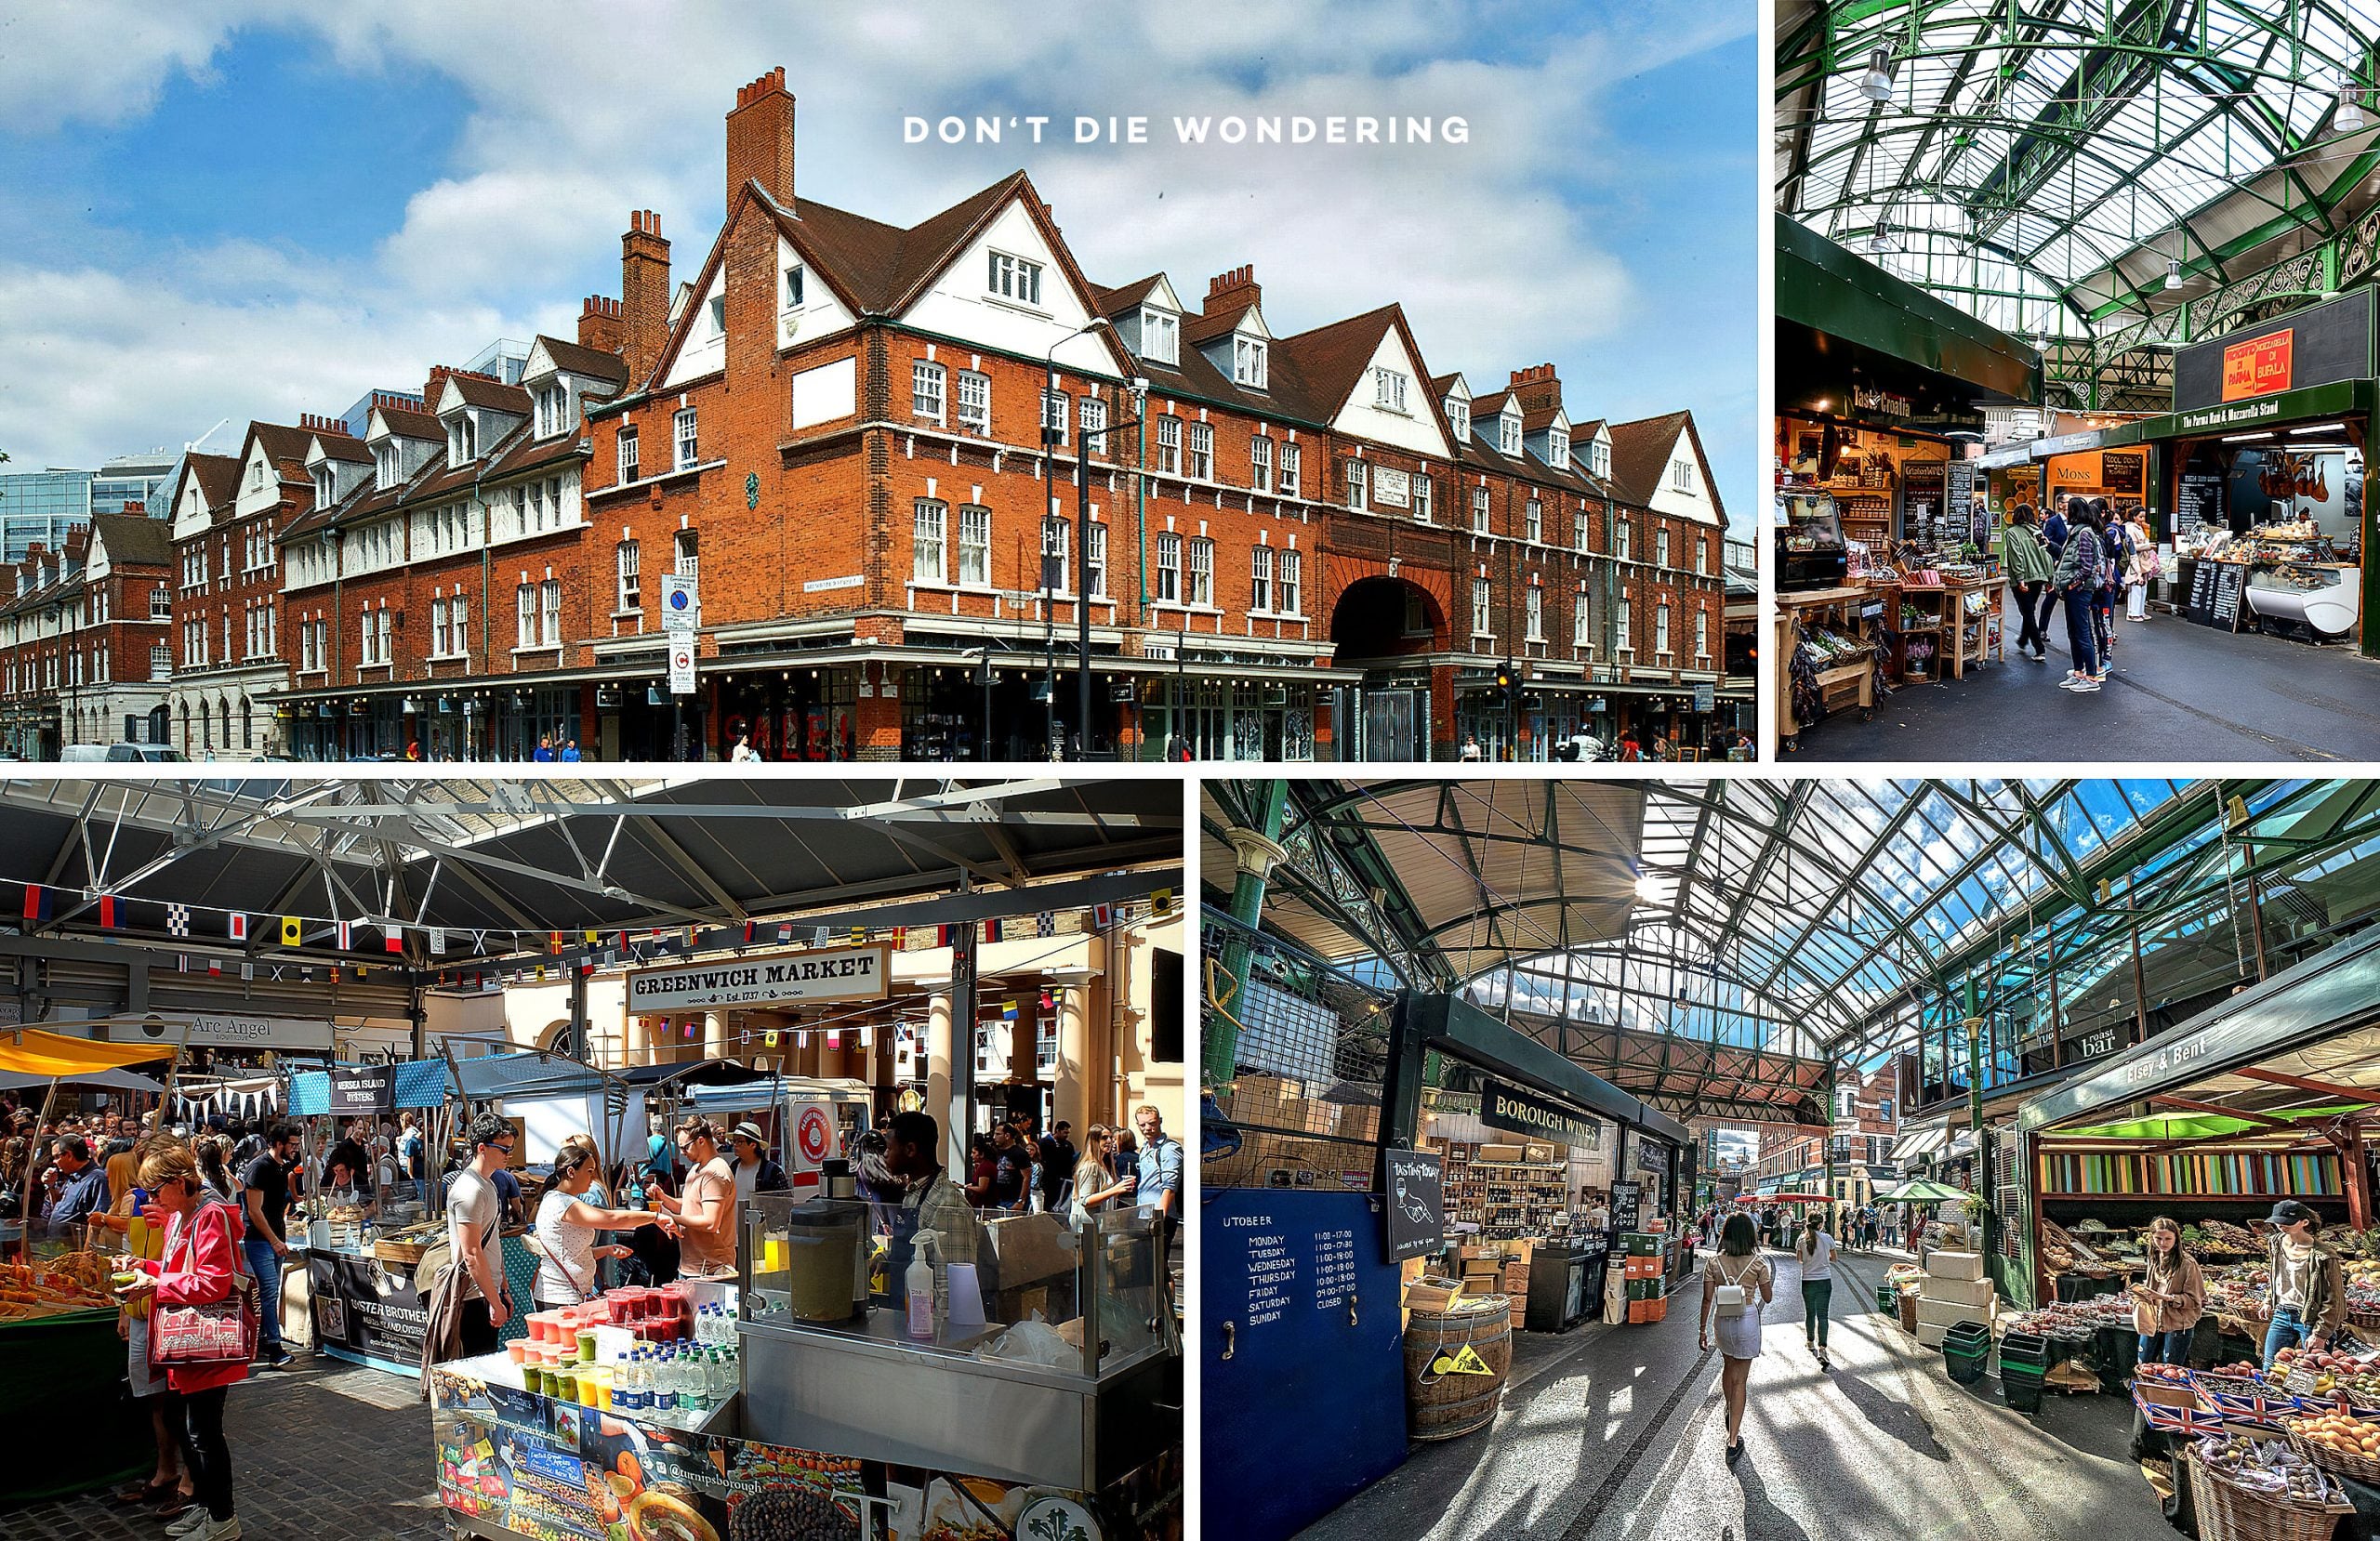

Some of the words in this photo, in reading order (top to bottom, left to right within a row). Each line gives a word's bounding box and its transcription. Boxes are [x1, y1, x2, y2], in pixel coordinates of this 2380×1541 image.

[2268, 350, 2277, 362] DI
[2256, 361, 2286, 379] BUFALA
[1881, 390, 1911, 418] Croatia
[2259, 400, 2280, 417] Stand
[634, 967, 759, 996] GREENWICH
[765, 955, 874, 984] MARKET
[742, 990, 760, 1002] 1737
[192, 1016, 221, 1034] Arc
[225, 1019, 271, 1040] Angel
[2089, 1028, 2114, 1043] roast
[2082, 1035, 2116, 1058] bar
[2127, 1060, 2155, 1085] Elsey
[2158, 1052, 2168, 1071] &
[2173, 1036, 2207, 1066] Bent
[361, 1078, 386, 1089] ISLAND
[1495, 1095, 1564, 1132] BOROUGH
[1566, 1116, 1597, 1141] WINES
[1223, 1216, 1273, 1228] UTOBEER
[1249, 1235, 1285, 1247] MONDAY
[1248, 1247, 1286, 1259] TUESDAY
[1248, 1258, 1296, 1273] WEDNESDAY
[1248, 1271, 1296, 1286] THURSDAY
[1249, 1285, 1278, 1300] FRIDAY
[1248, 1296, 1291, 1313] SATURDAY
[1249, 1311, 1281, 1326] SUNDAY
[1316, 1297, 1342, 1310] CLOSED
[669, 1463, 763, 1495] @turnipsborough
[477, 1492, 489, 1503] and
[489, 1494, 510, 1508] other
